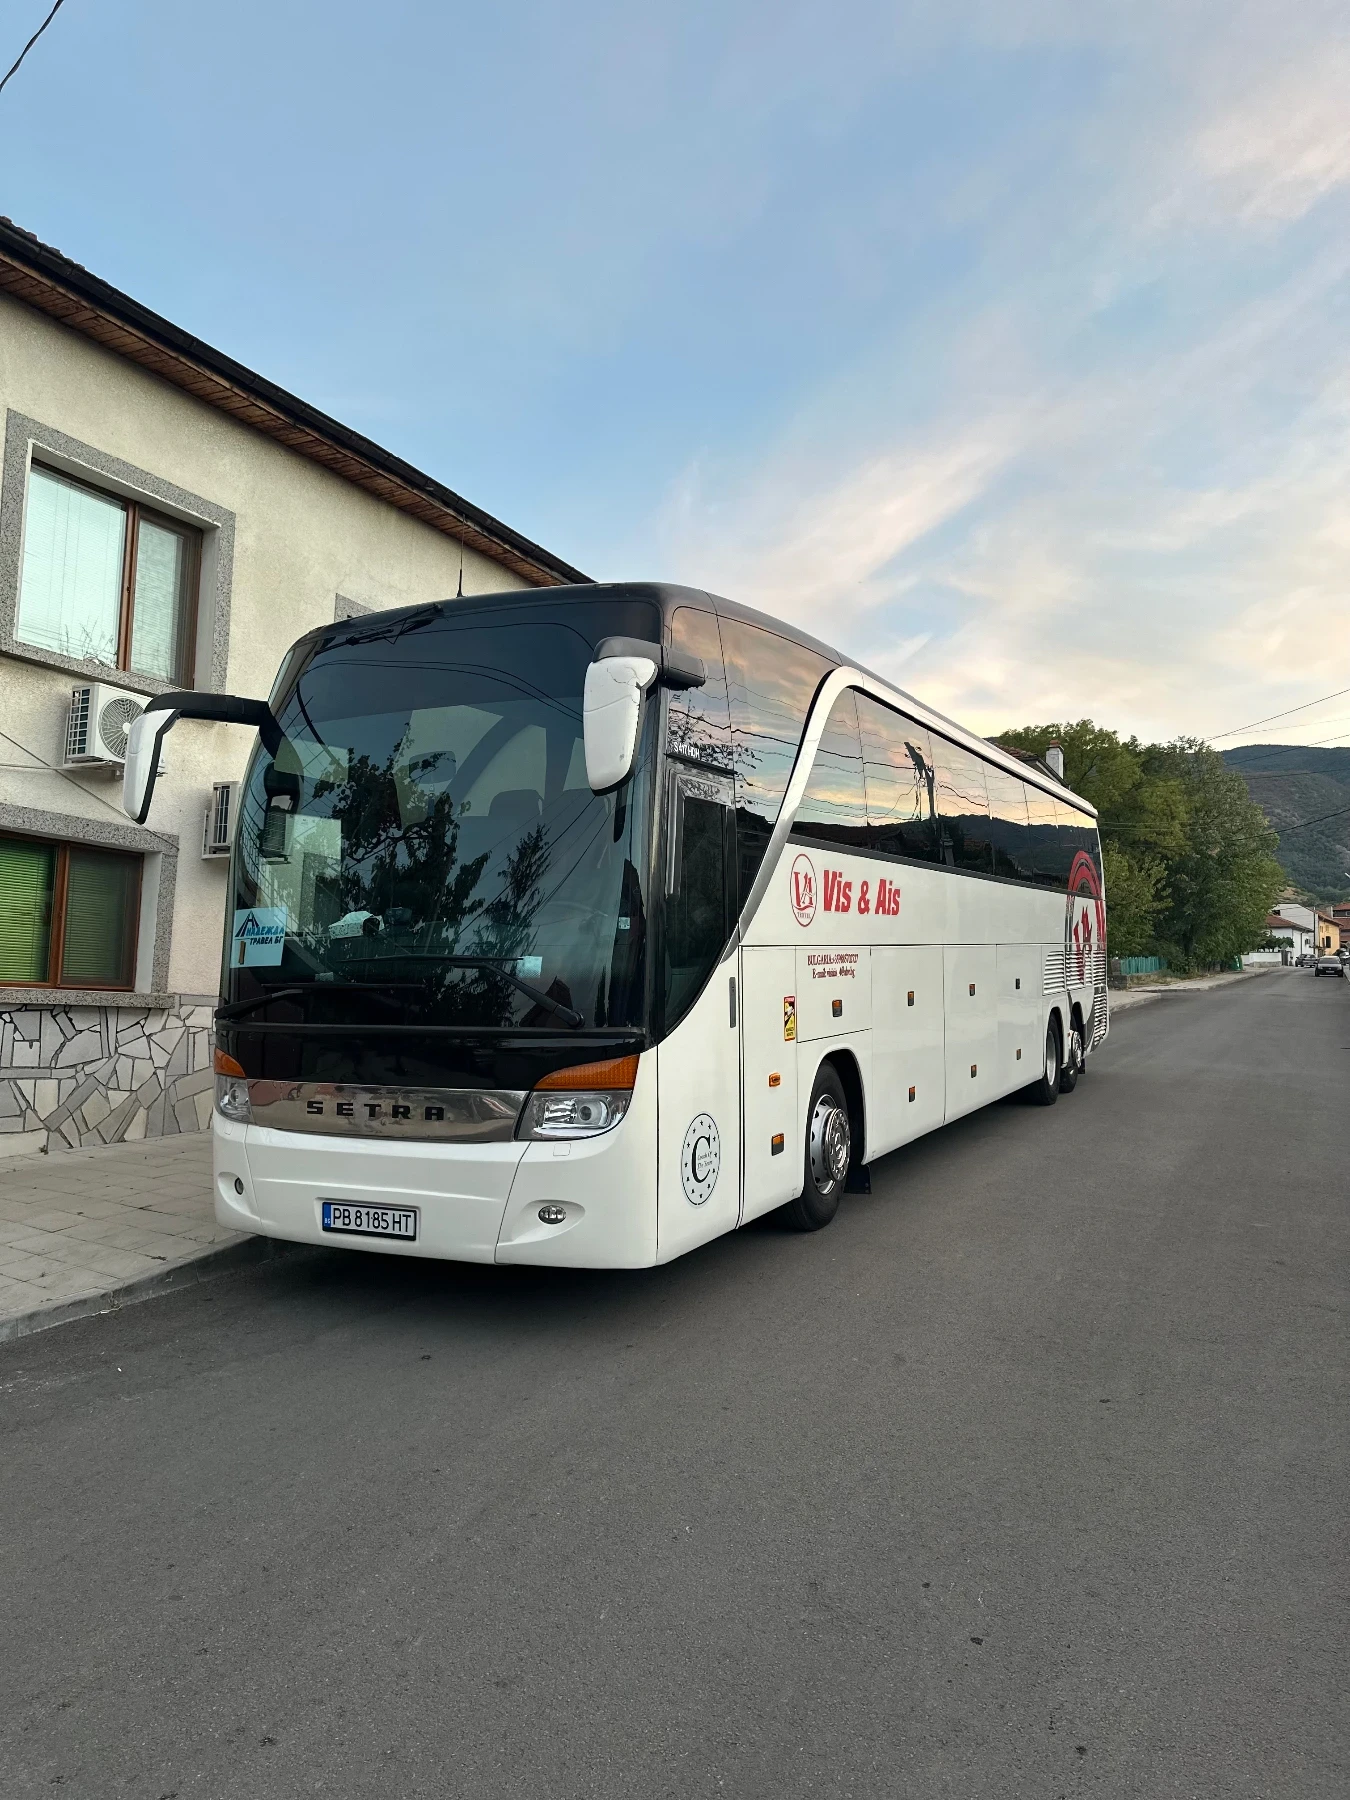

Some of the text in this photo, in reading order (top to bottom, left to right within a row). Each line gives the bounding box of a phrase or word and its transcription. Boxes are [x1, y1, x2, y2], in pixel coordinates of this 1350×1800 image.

[823, 869, 901, 916] Vis & Ais
[249, 936, 273, 946] ТРАВЕЛ
[306, 1100, 445, 1121] SETRA
[333, 1207, 412, 1233] PB 8185 HT
